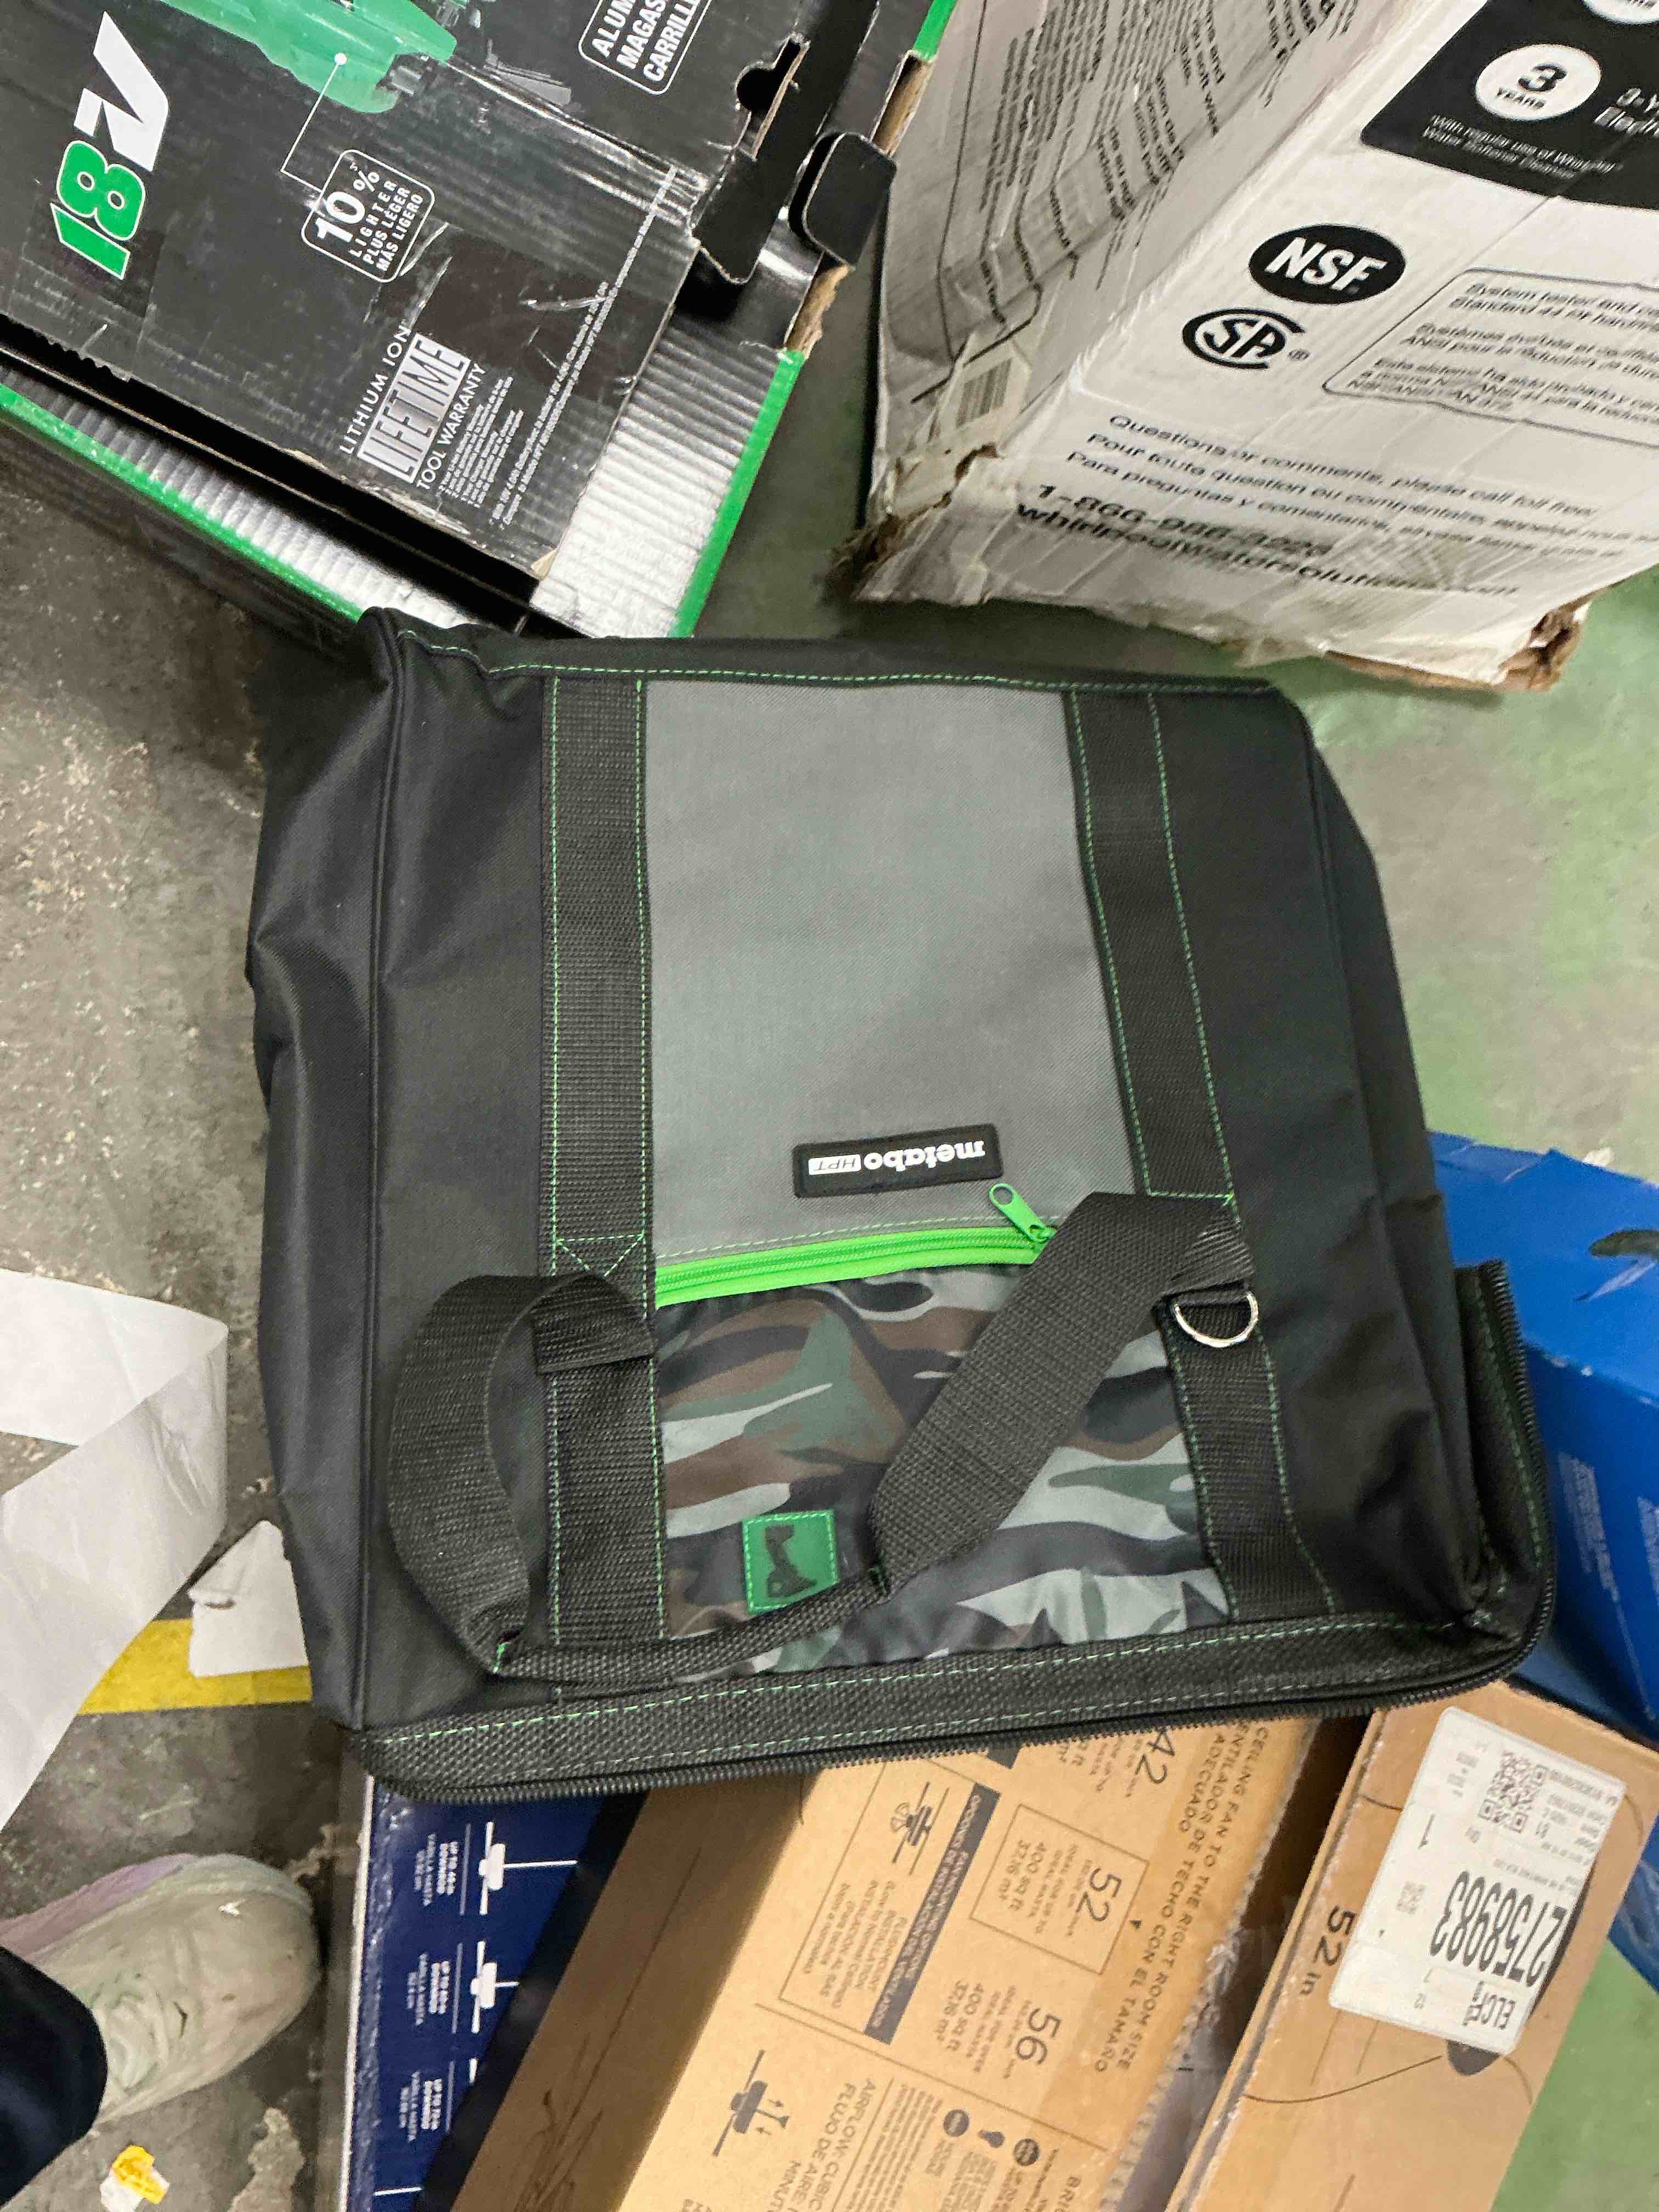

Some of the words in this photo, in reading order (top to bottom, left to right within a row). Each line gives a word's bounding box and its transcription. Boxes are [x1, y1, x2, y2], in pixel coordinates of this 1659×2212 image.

[1519, 63, 1568, 92] 3
[50, 11, 169, 280] 18V
[347, 179, 398, 258] LIGHTER
[391, 192, 425, 241] LIGERO
[361, 228, 389, 265] PLUS
[1265, 236, 1391, 295] NSF
[336, 371, 392, 455] LITHIUM
[380, 323, 414, 367] ION
[358, 337, 470, 478] LIFETIME
[414, 447, 449, 493] TOOL
[436, 362, 485, 449] WARRANTY
[1109, 414, 1228, 456] Questions
[812, 1156, 857, 1172] HPT
[862, 1139, 986, 1175] metabo
[1132, 1728, 1182, 1787] 42
[1174, 1733, 1230, 1834] ADECUADO
[1198, 1719, 1252, 1825] ENTILADOR
[1184, 1826, 1207, 1856] DE
[1214, 1801, 1240, 1839] FAN
[1024, 1839, 1049, 1875] 400
[1201, 1841, 1223, 1870] TO
[1073, 1865, 1126, 1926] 52
[1158, 1857, 1195, 1920] TECHO
[1184, 1873, 1210, 1910] THE
[1140, 1923, 1168, 1964] CON
[1159, 1911, 1195, 1968] RIGHT
[1312, 1905, 1357, 1967] 52
[1430, 1870, 1568, 1988] 2758983
[961, 1980, 986, 2017] 400
[1129, 1967, 1149, 1991] EL
[1134, 1971, 1169, 2027] ROOM
[1010, 2004, 1064, 2069] 56
[1116, 2029, 1144, 2072] SIZE
[822, 2080, 857, 2137] FLUJO
[811, 2136, 832, 2163] DE
